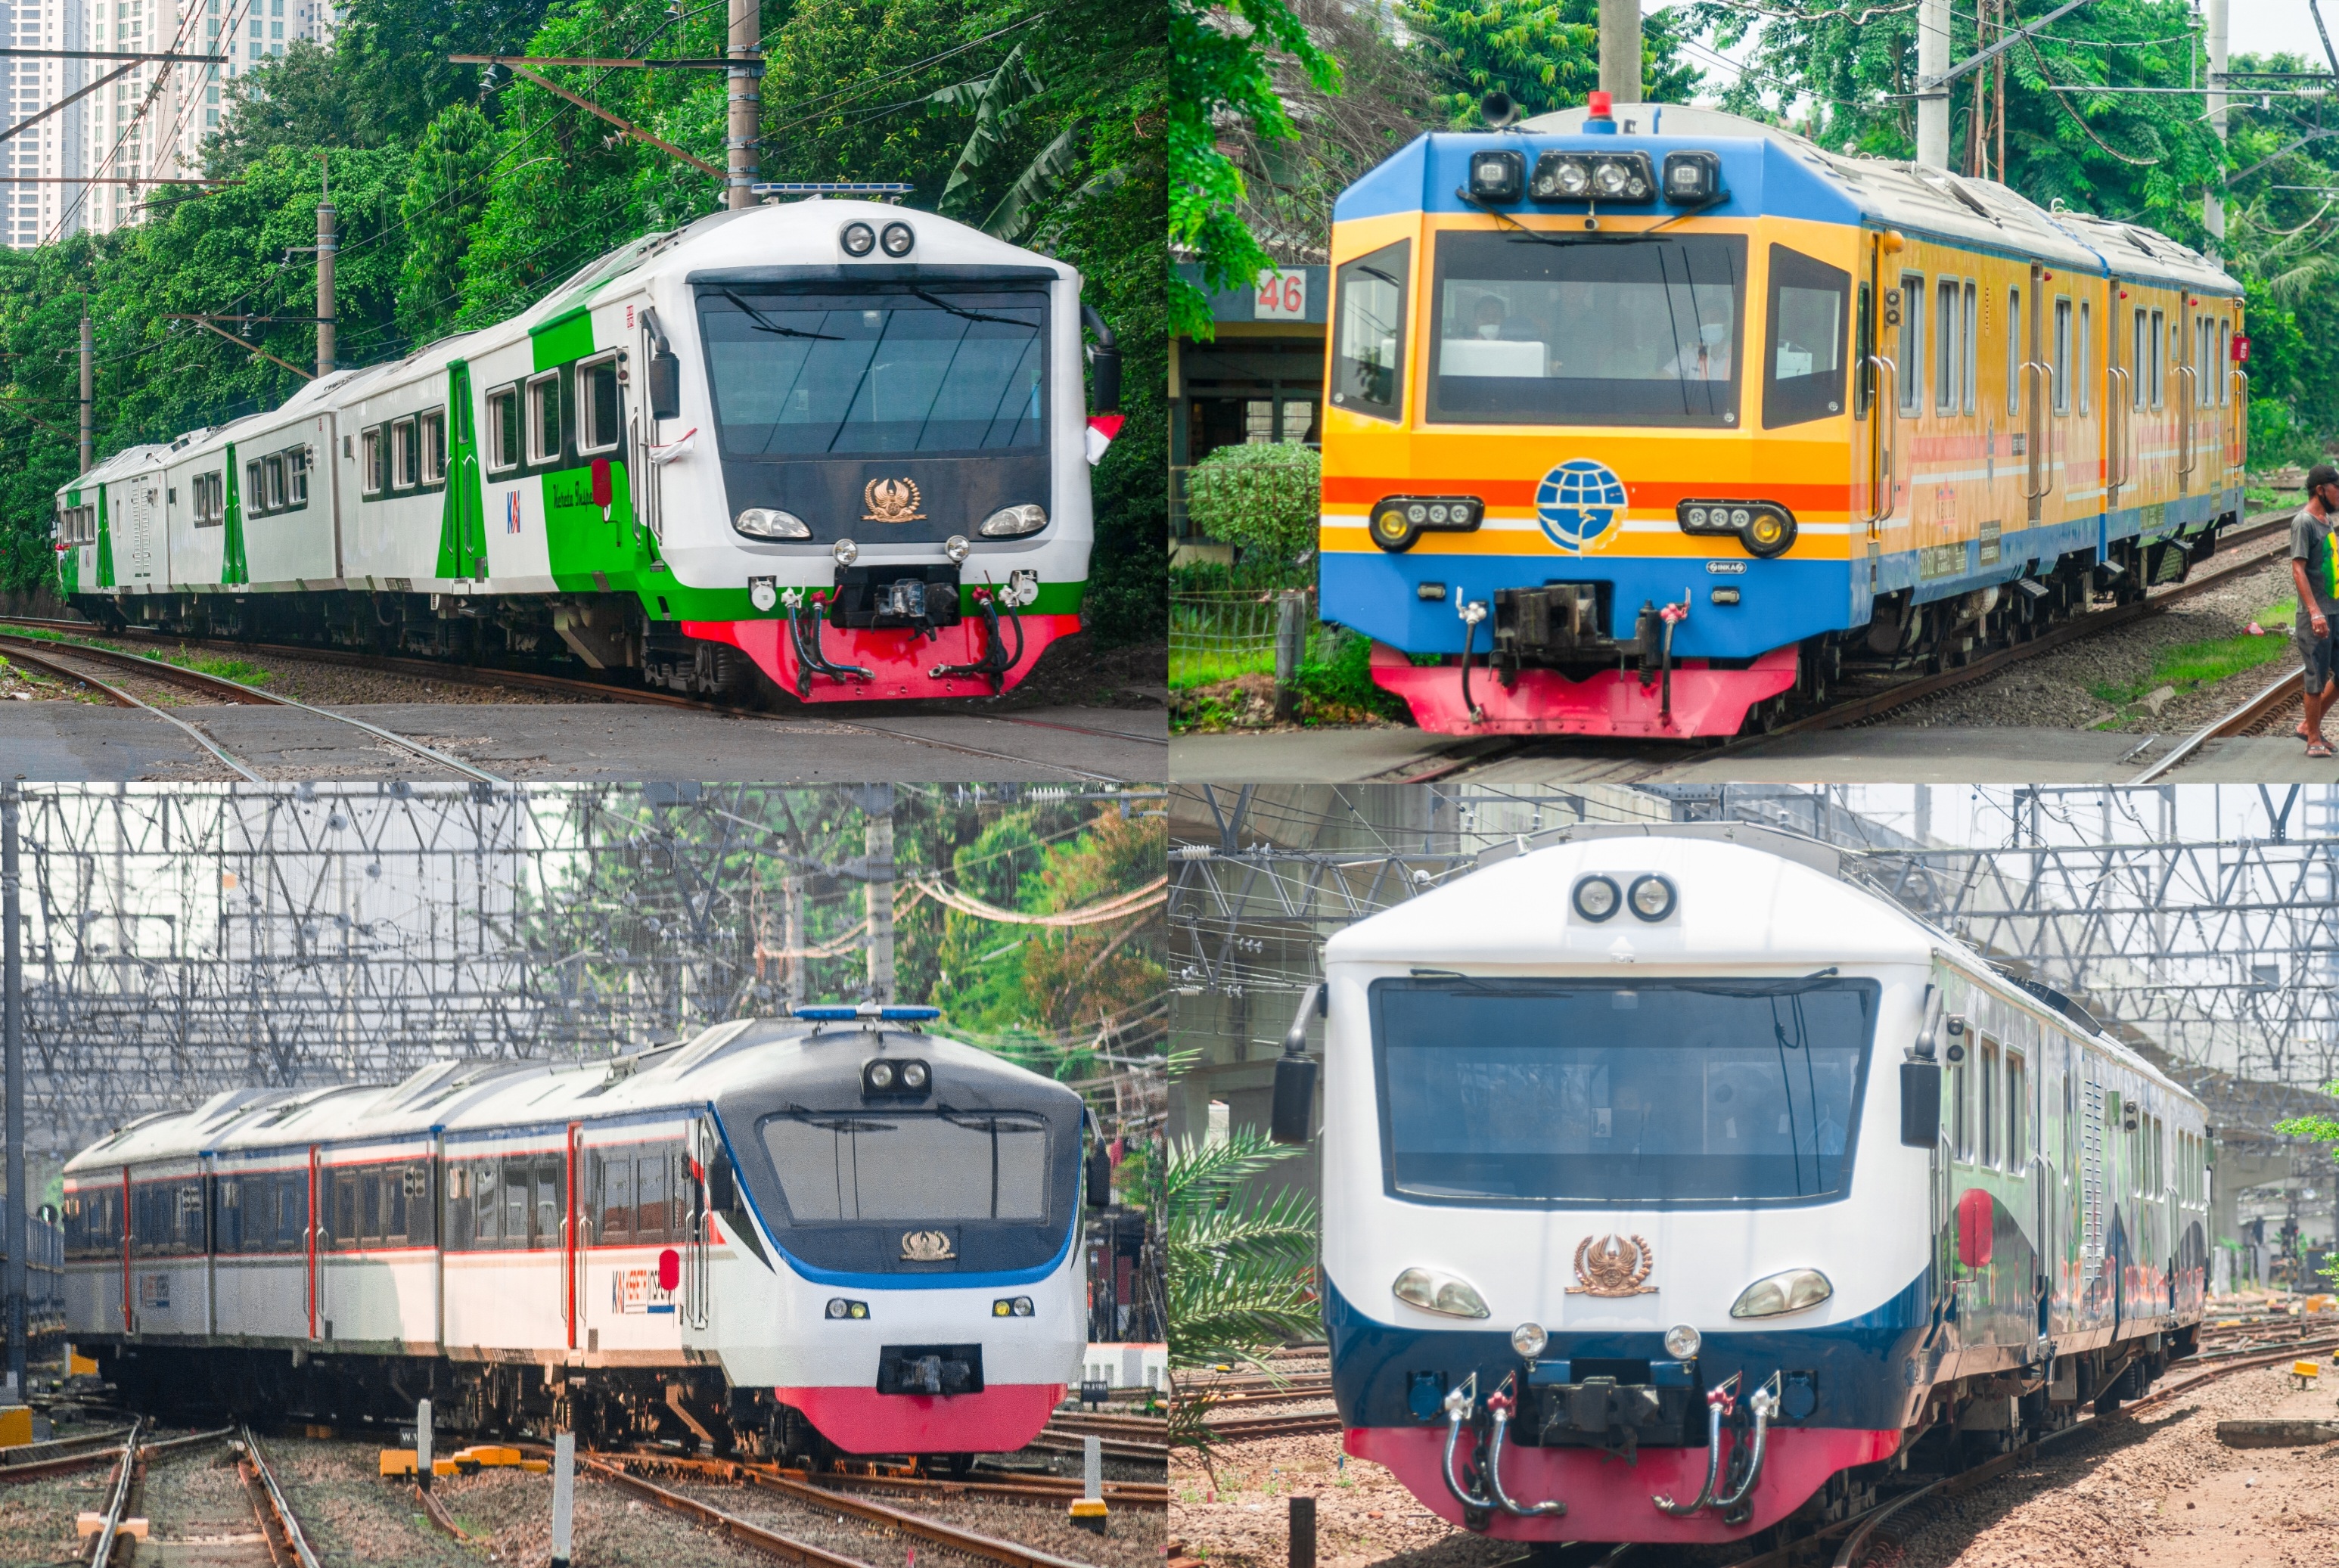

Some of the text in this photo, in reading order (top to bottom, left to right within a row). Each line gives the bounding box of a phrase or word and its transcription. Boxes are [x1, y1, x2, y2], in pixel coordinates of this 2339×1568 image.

[1259, 276, 1302, 312] 46
[507, 490, 520, 534] KAI
[553, 480, 594, 512] Kereta Inspe
[612, 1271, 624, 1314] KAI
